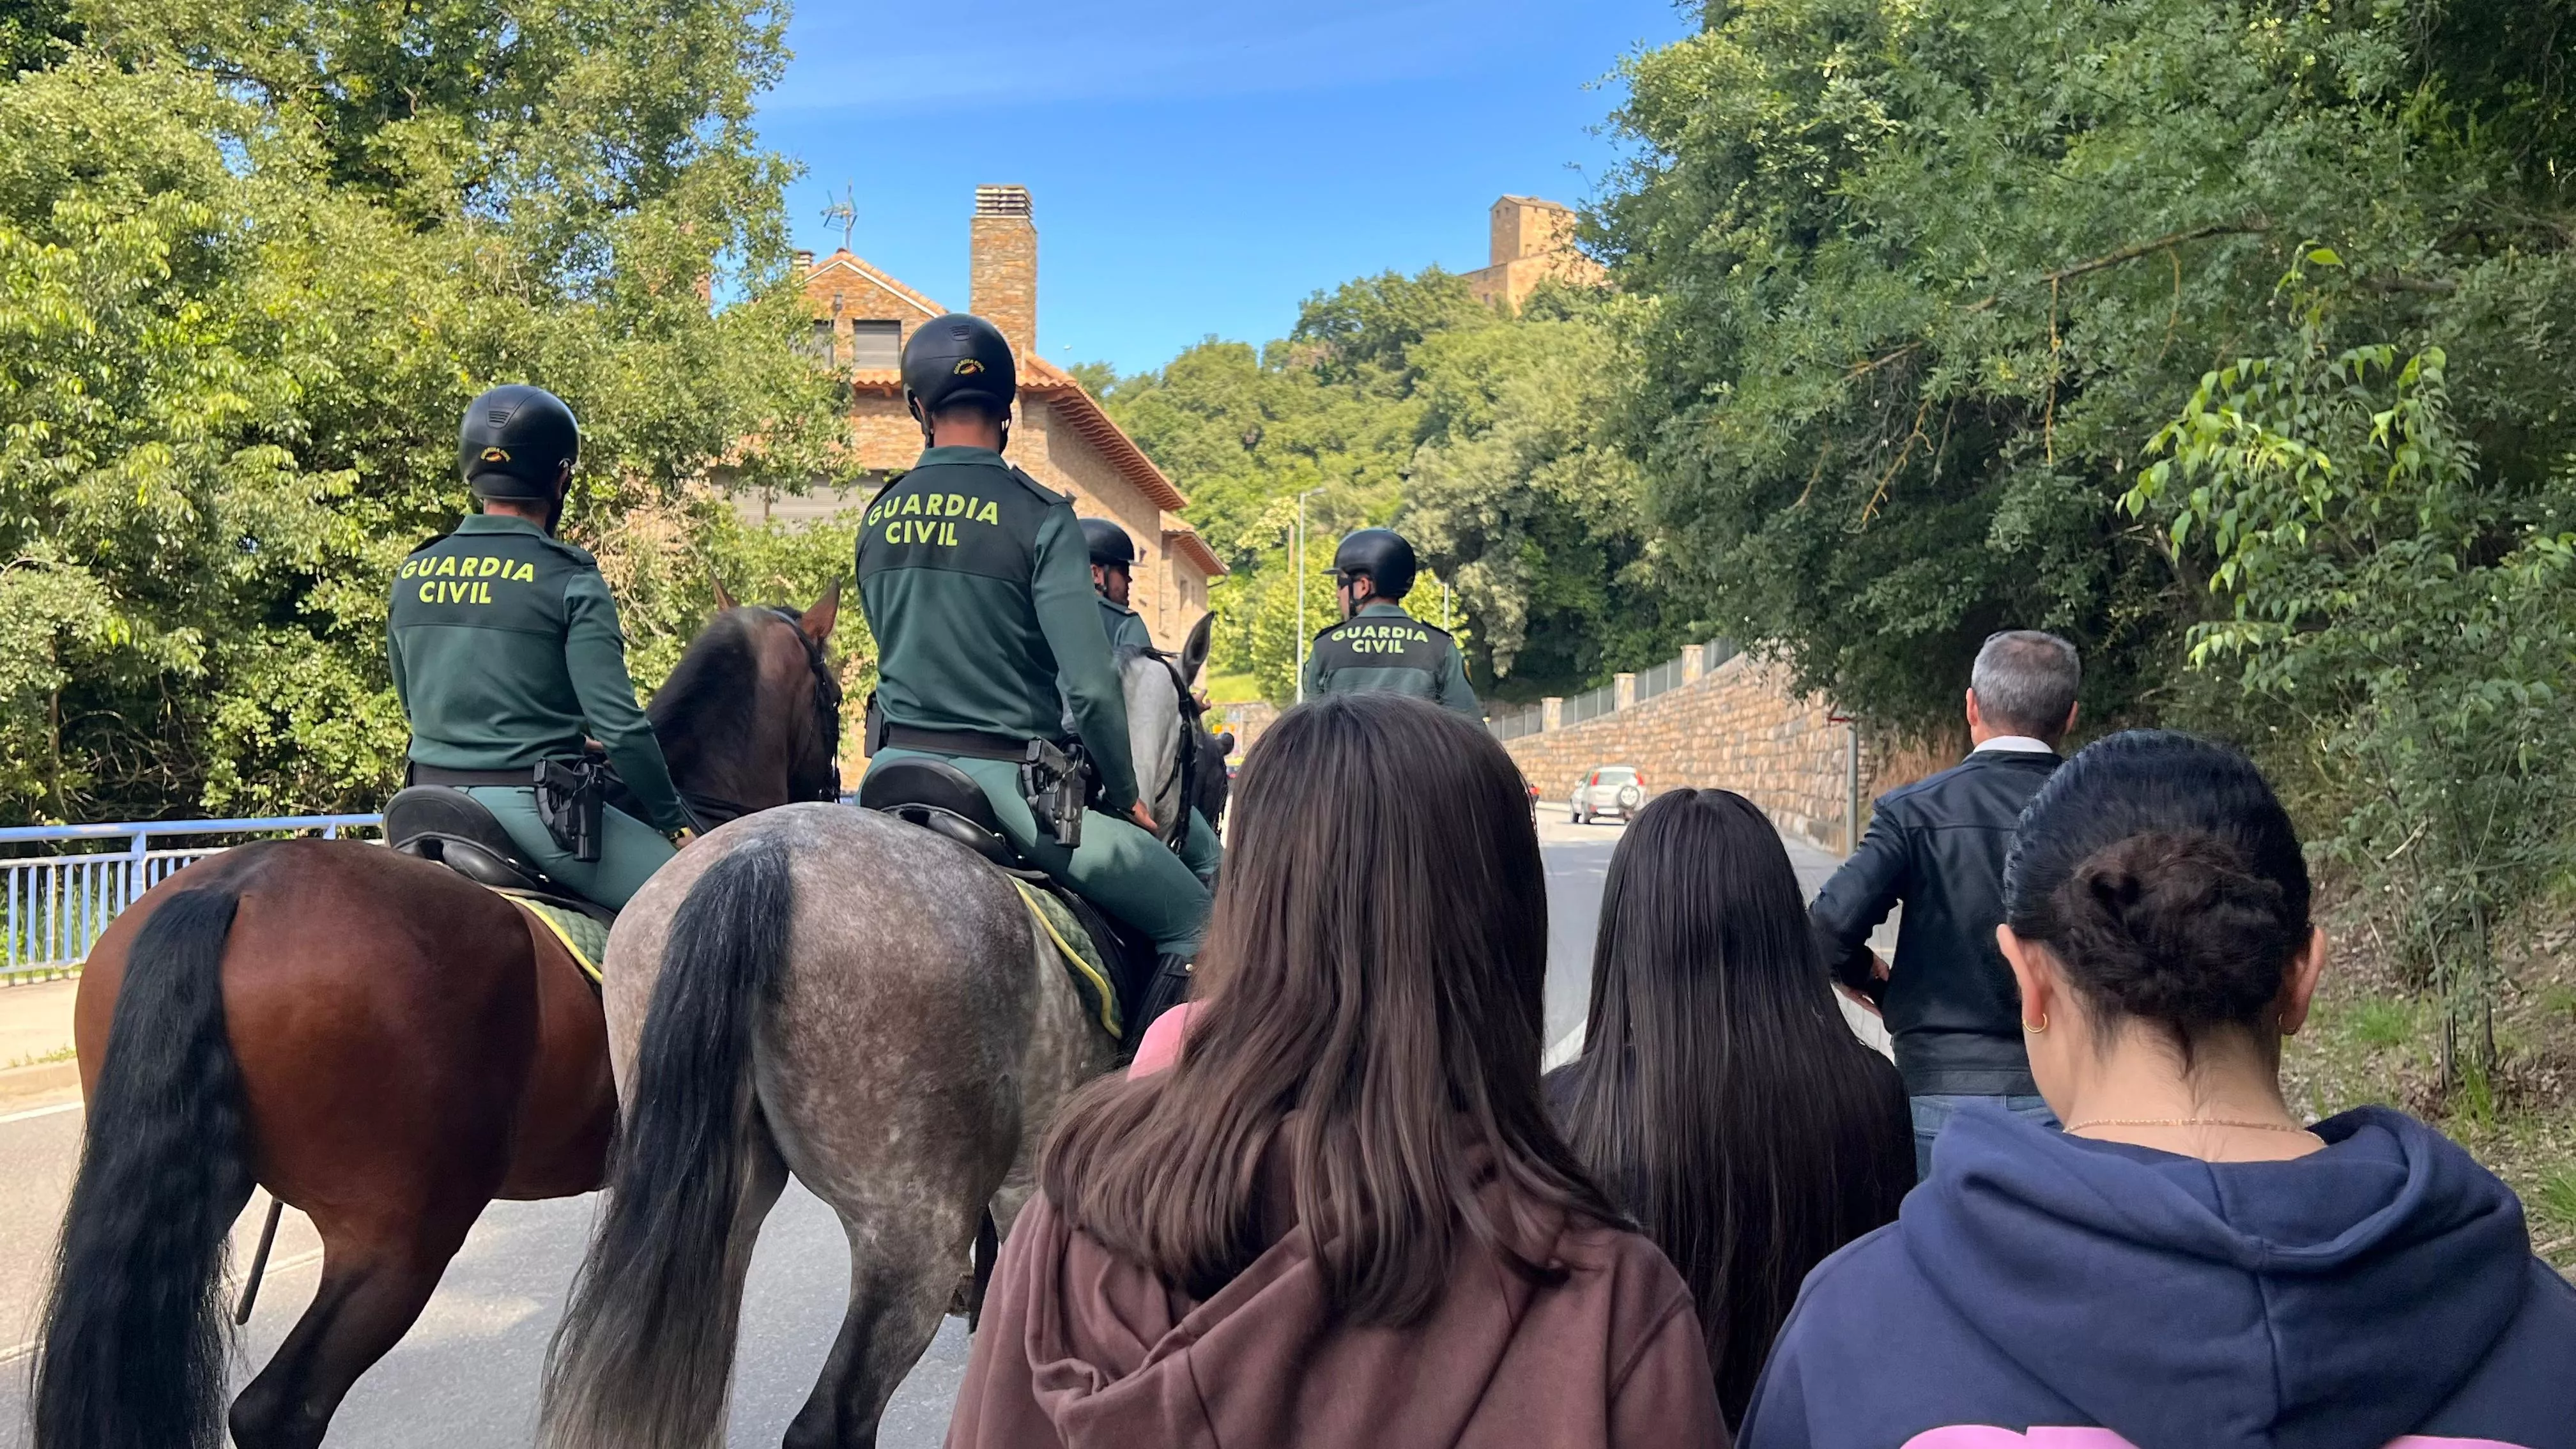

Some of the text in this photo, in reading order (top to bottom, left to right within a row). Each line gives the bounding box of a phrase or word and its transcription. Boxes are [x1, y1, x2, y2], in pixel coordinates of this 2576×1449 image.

[868, 494, 999, 525] GUARDIA
[885, 521, 958, 546] CIVIL
[401, 556, 533, 582] GUARDIA
[419, 581, 491, 604] CIVIL
[1331, 626, 1429, 642] GUARDIA
[1352, 640, 1404, 653] CIVIL
